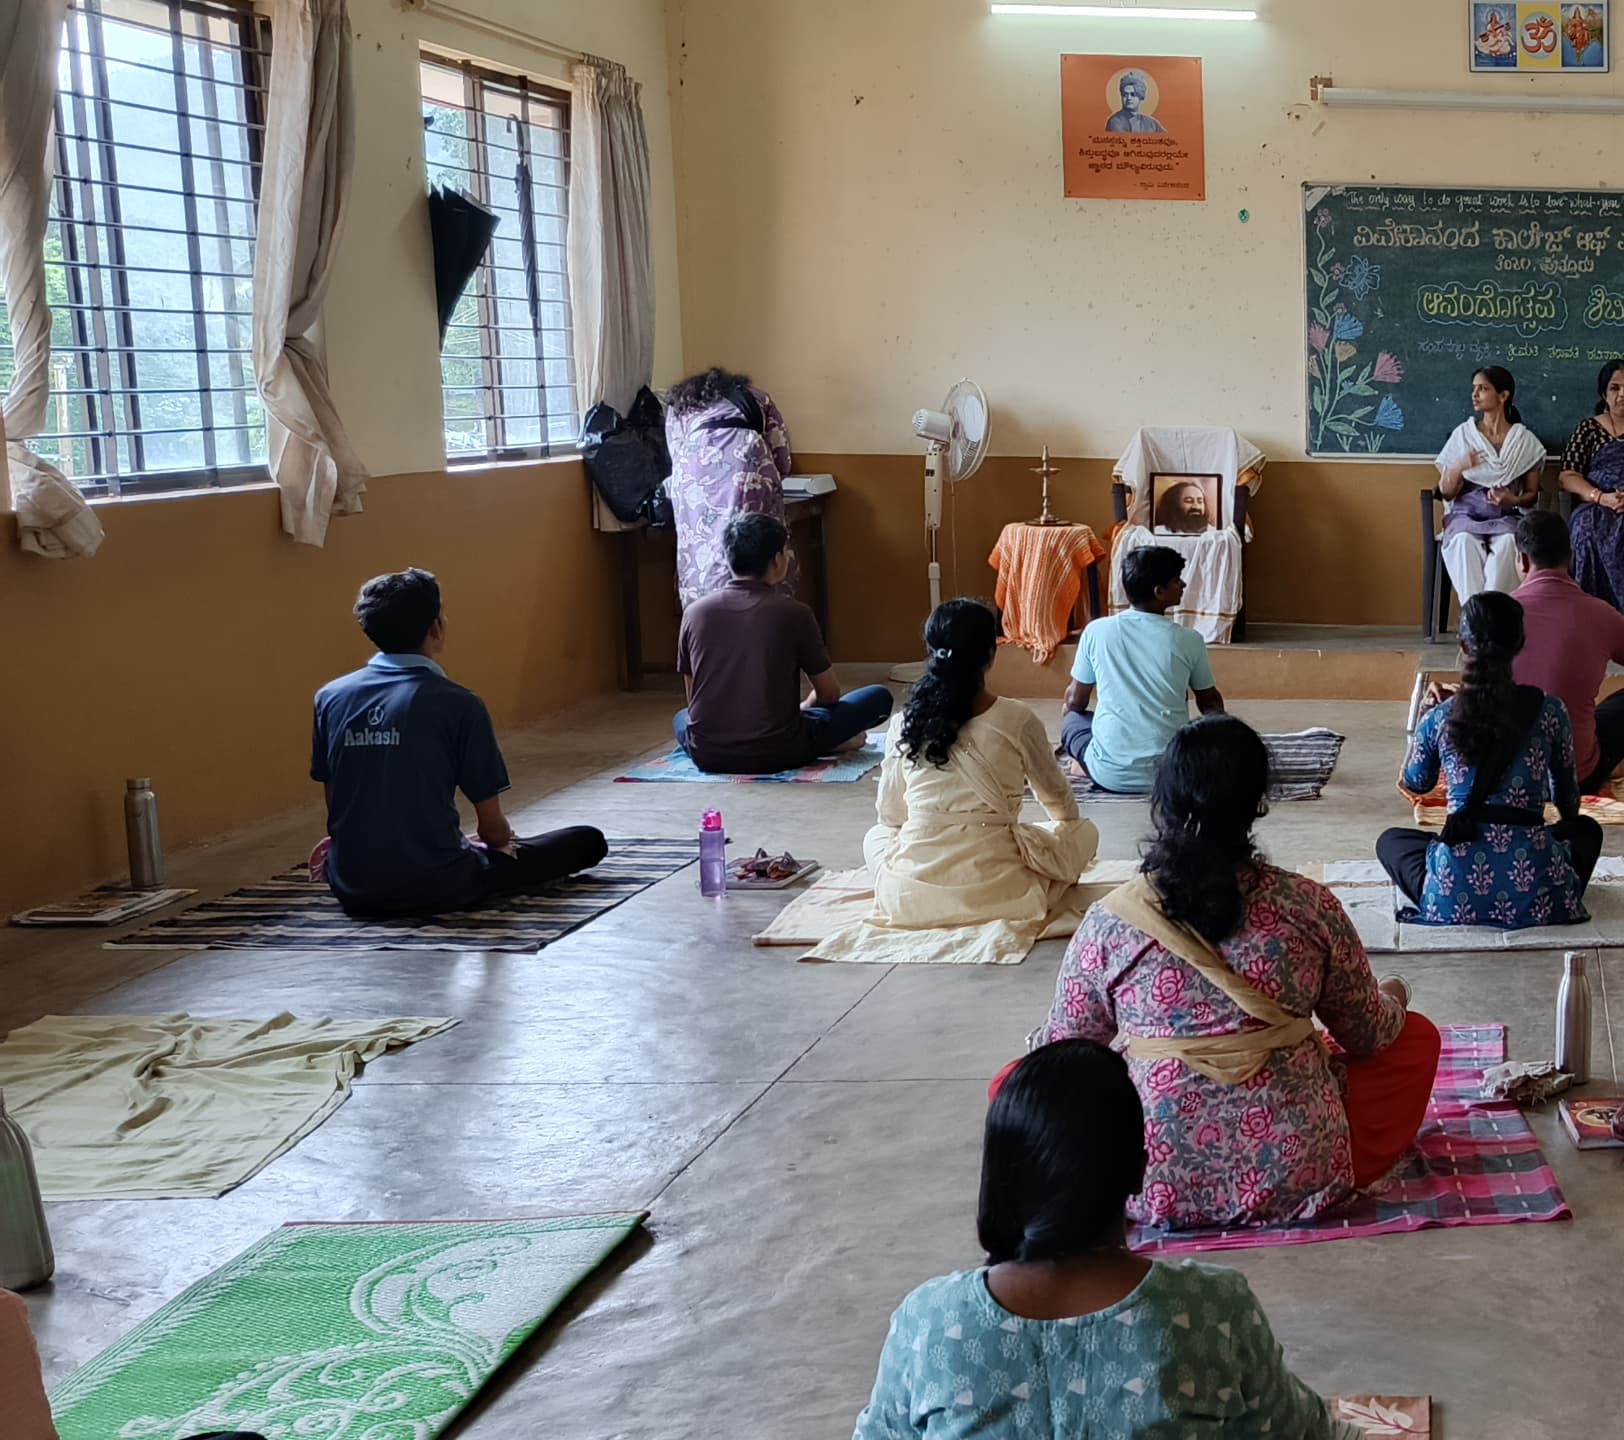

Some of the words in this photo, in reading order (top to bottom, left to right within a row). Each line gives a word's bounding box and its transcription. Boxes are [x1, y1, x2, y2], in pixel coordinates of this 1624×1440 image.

[1368, 192, 1390, 211] only
[1393, 193, 1416, 211] way
[1422, 191, 1434, 205] to
[1437, 193, 1451, 206] do
[1455, 195, 1483, 213] great
[1489, 193, 1514, 207] work
[1353, 217, 1481, 249] ವಿವೇಕಾನಂದ
[1421, 284, 1557, 330] ಆನಂದೋತ್ಸವ
[344, 727, 400, 747] Aakash
